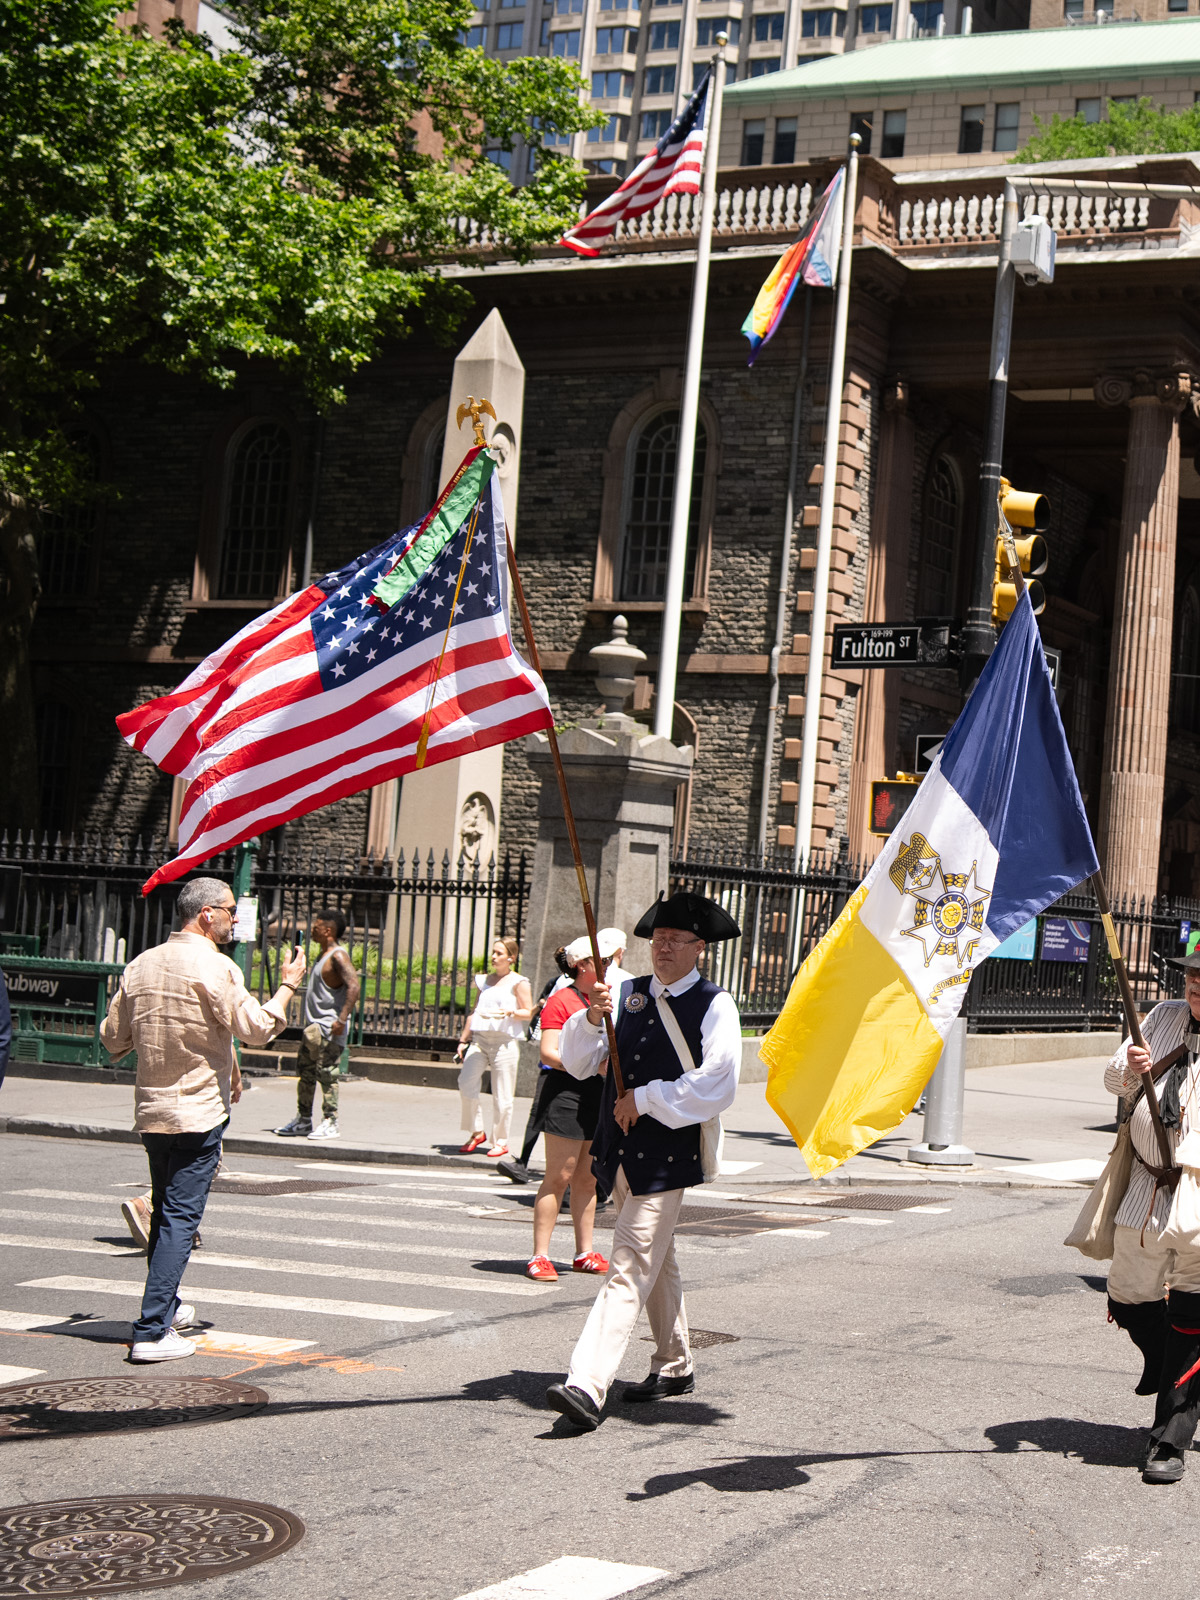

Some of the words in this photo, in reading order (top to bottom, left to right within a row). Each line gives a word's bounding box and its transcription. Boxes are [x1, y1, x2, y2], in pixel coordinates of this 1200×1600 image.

[870, 629, 893, 638] 169-199
[841, 637, 896, 658] Fulton
[899, 636, 911, 648] ST
[936, 979, 954, 990] SONS
[953, 975, 962, 984] OF
